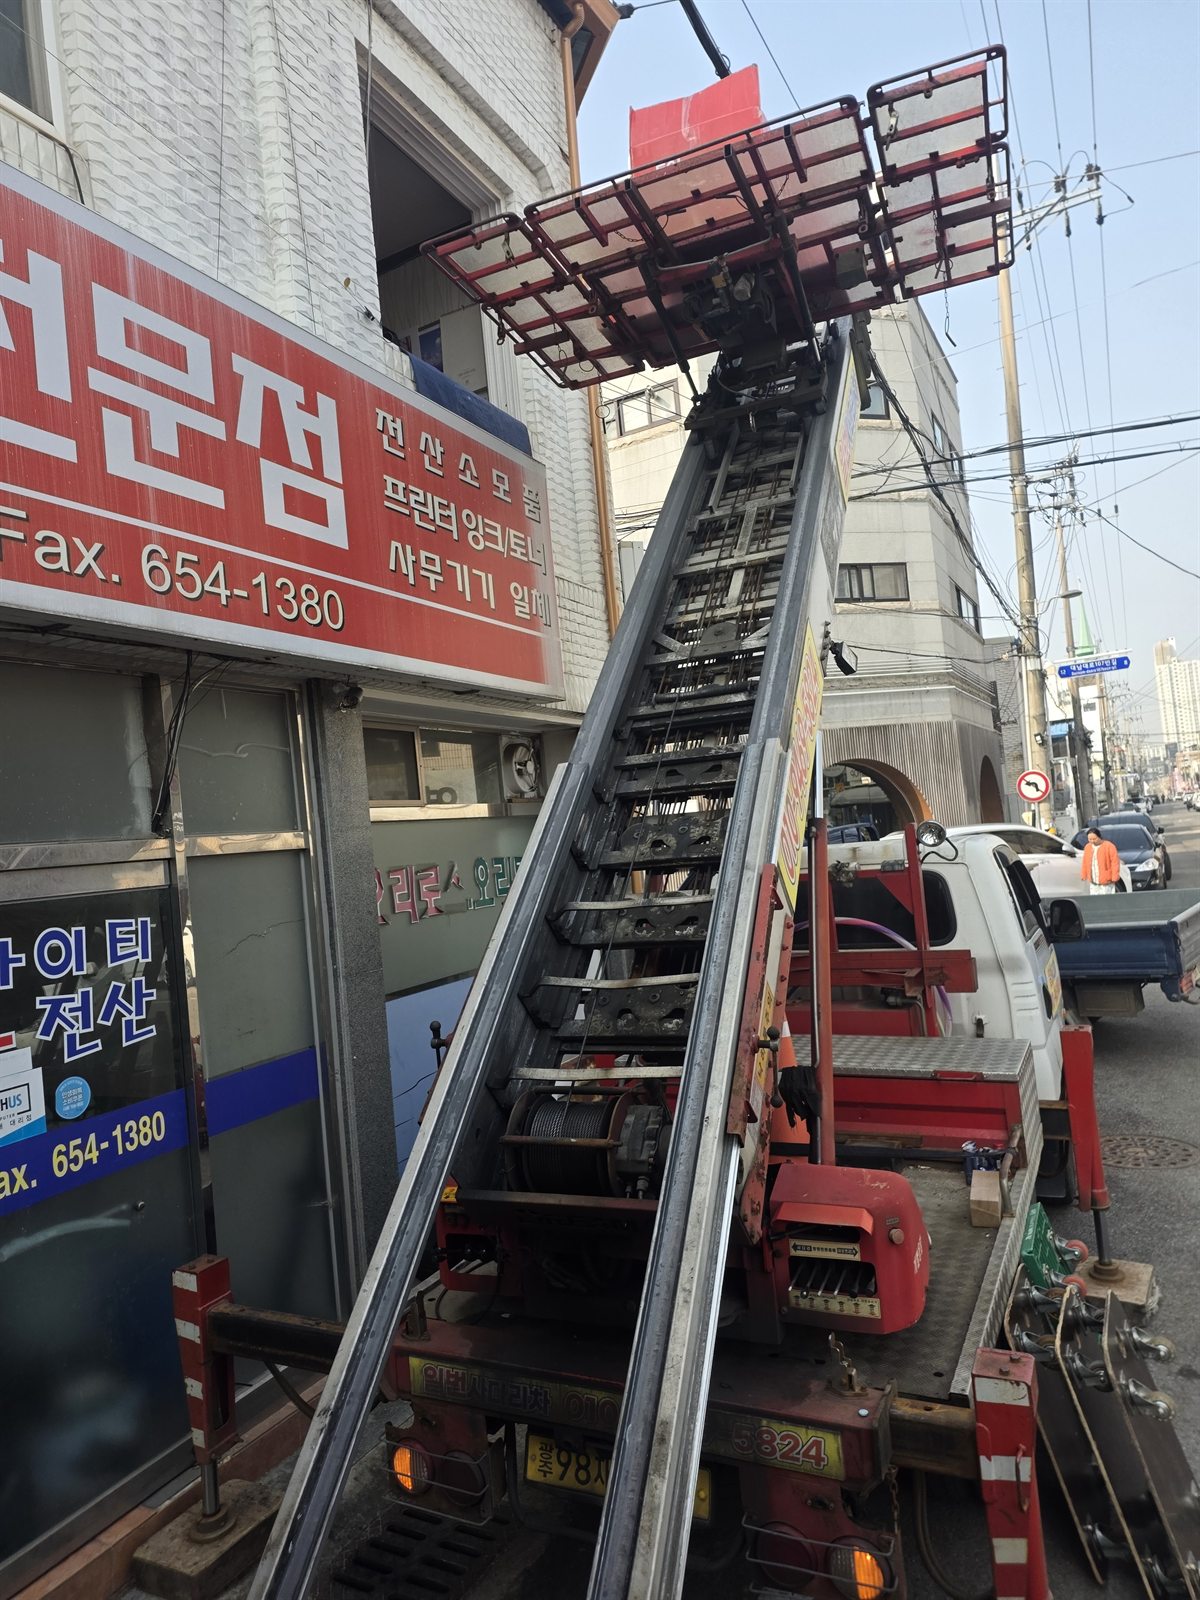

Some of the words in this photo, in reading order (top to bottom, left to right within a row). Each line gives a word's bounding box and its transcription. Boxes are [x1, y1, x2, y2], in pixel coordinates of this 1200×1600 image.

[141, 543, 345, 632] 654-1380
[389, 540, 496, 609] 사무기기
[36, 976, 157, 1063] 전산
[52, 1111, 166, 1178] 654-1380
